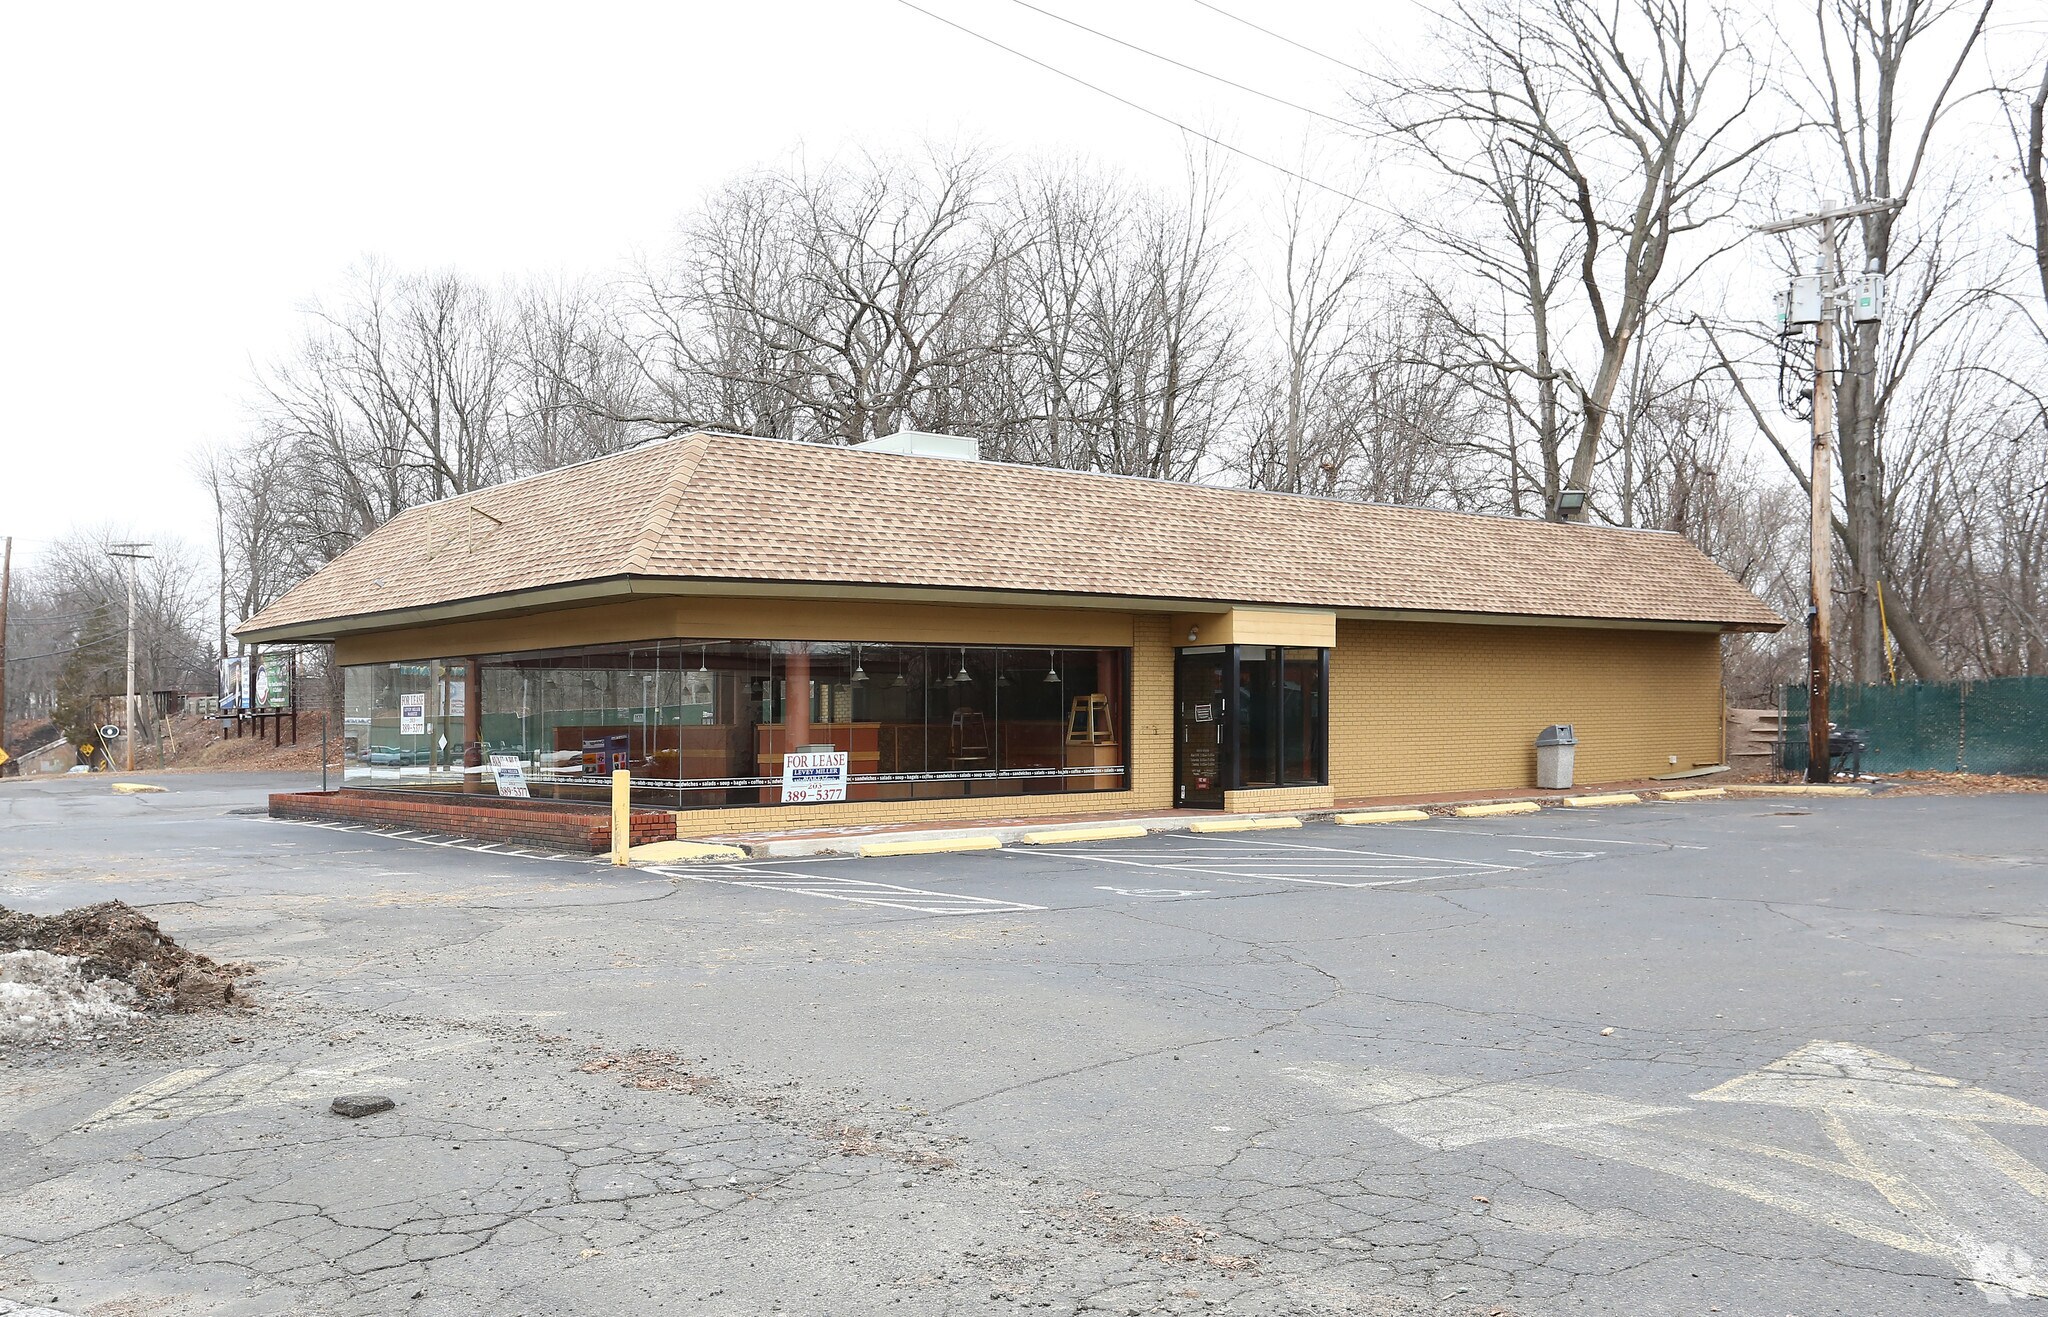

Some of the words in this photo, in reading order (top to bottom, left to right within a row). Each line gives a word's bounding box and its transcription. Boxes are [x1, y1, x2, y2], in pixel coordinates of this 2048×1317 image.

[787, 755, 808, 768] FOR
[812, 753, 845, 767] LEASE
[785, 788, 842, 802] 389-5377
